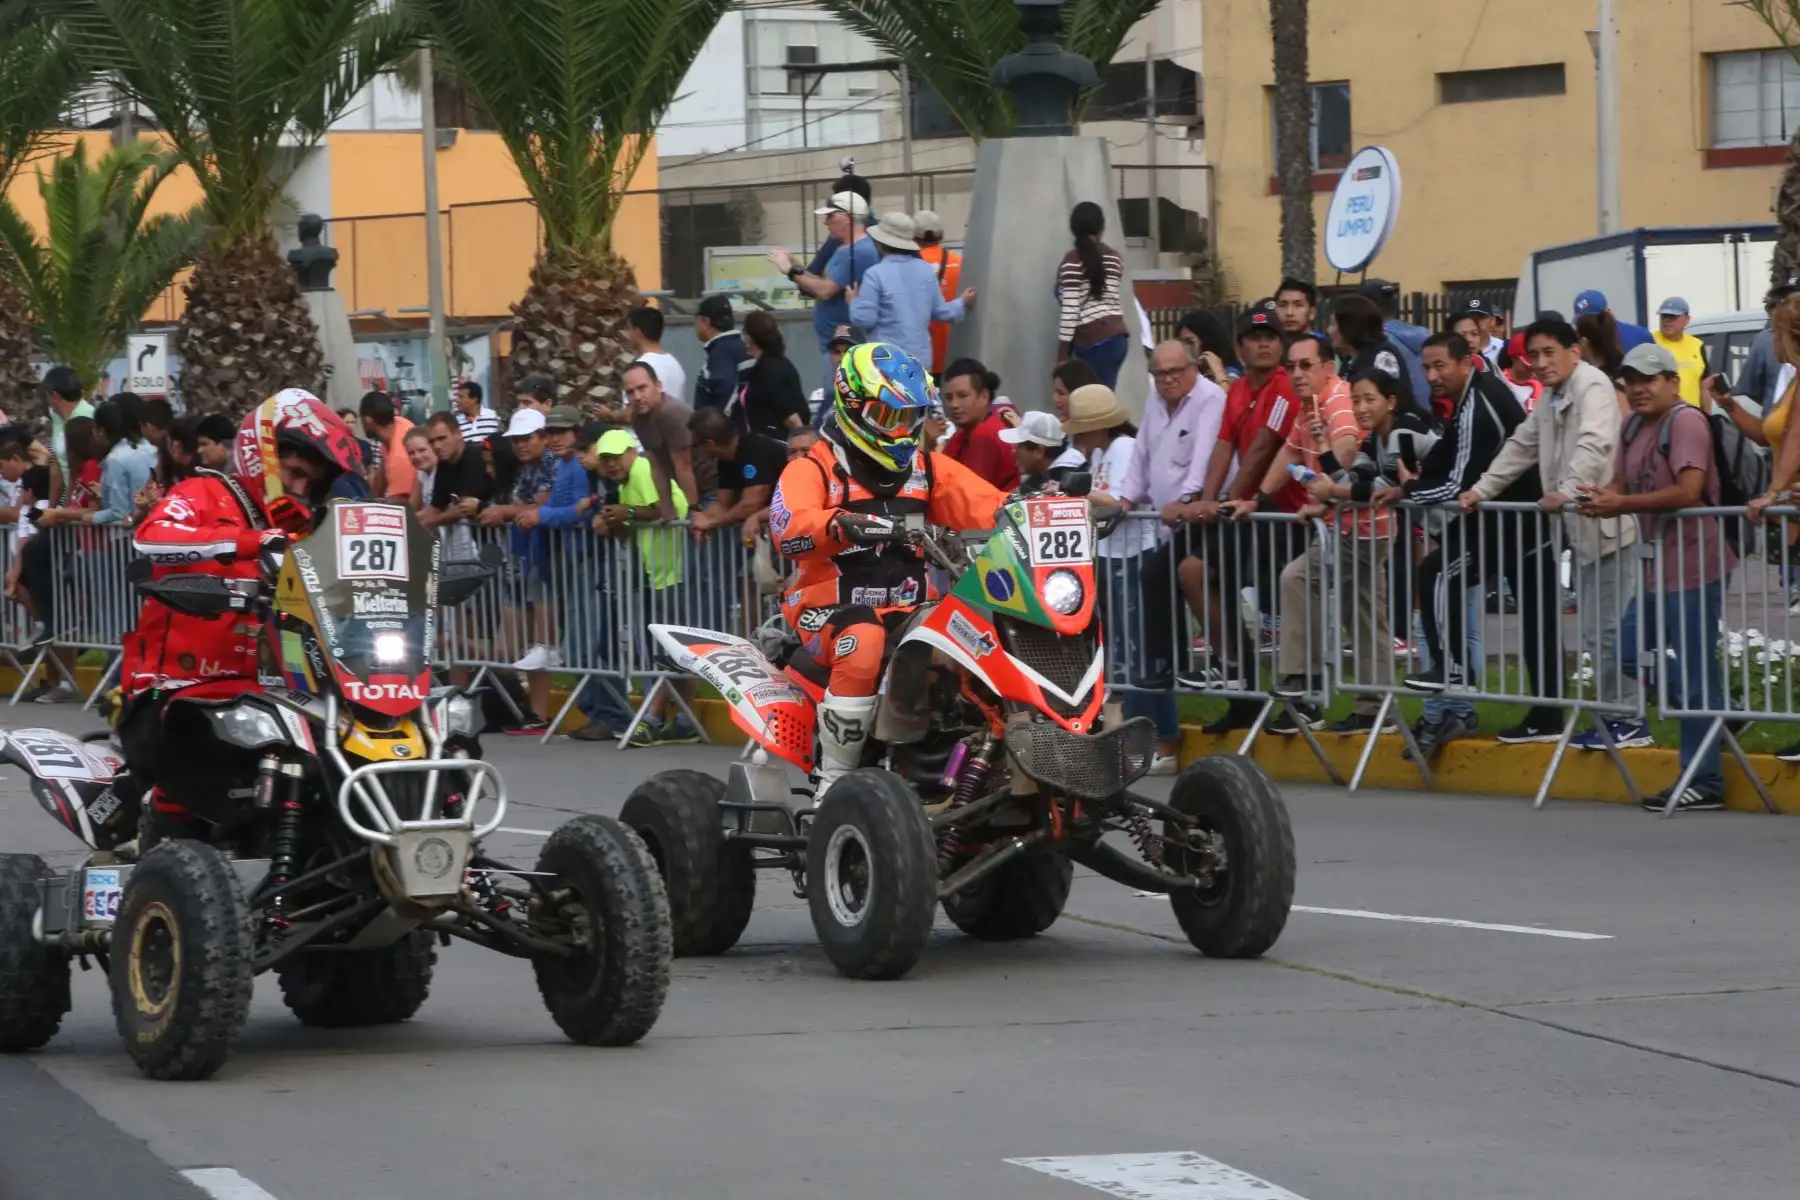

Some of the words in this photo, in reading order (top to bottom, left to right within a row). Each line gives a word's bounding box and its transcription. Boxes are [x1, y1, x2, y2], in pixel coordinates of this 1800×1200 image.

[133, 376, 164, 388] SOLO
[1051, 509, 1084, 520] MOTUL
[348, 539, 397, 572] 287
[1039, 530, 1083, 560] 282
[705, 650, 769, 686] 282
[343, 681, 425, 700] TOTAL
[14, 737, 86, 769] 287
